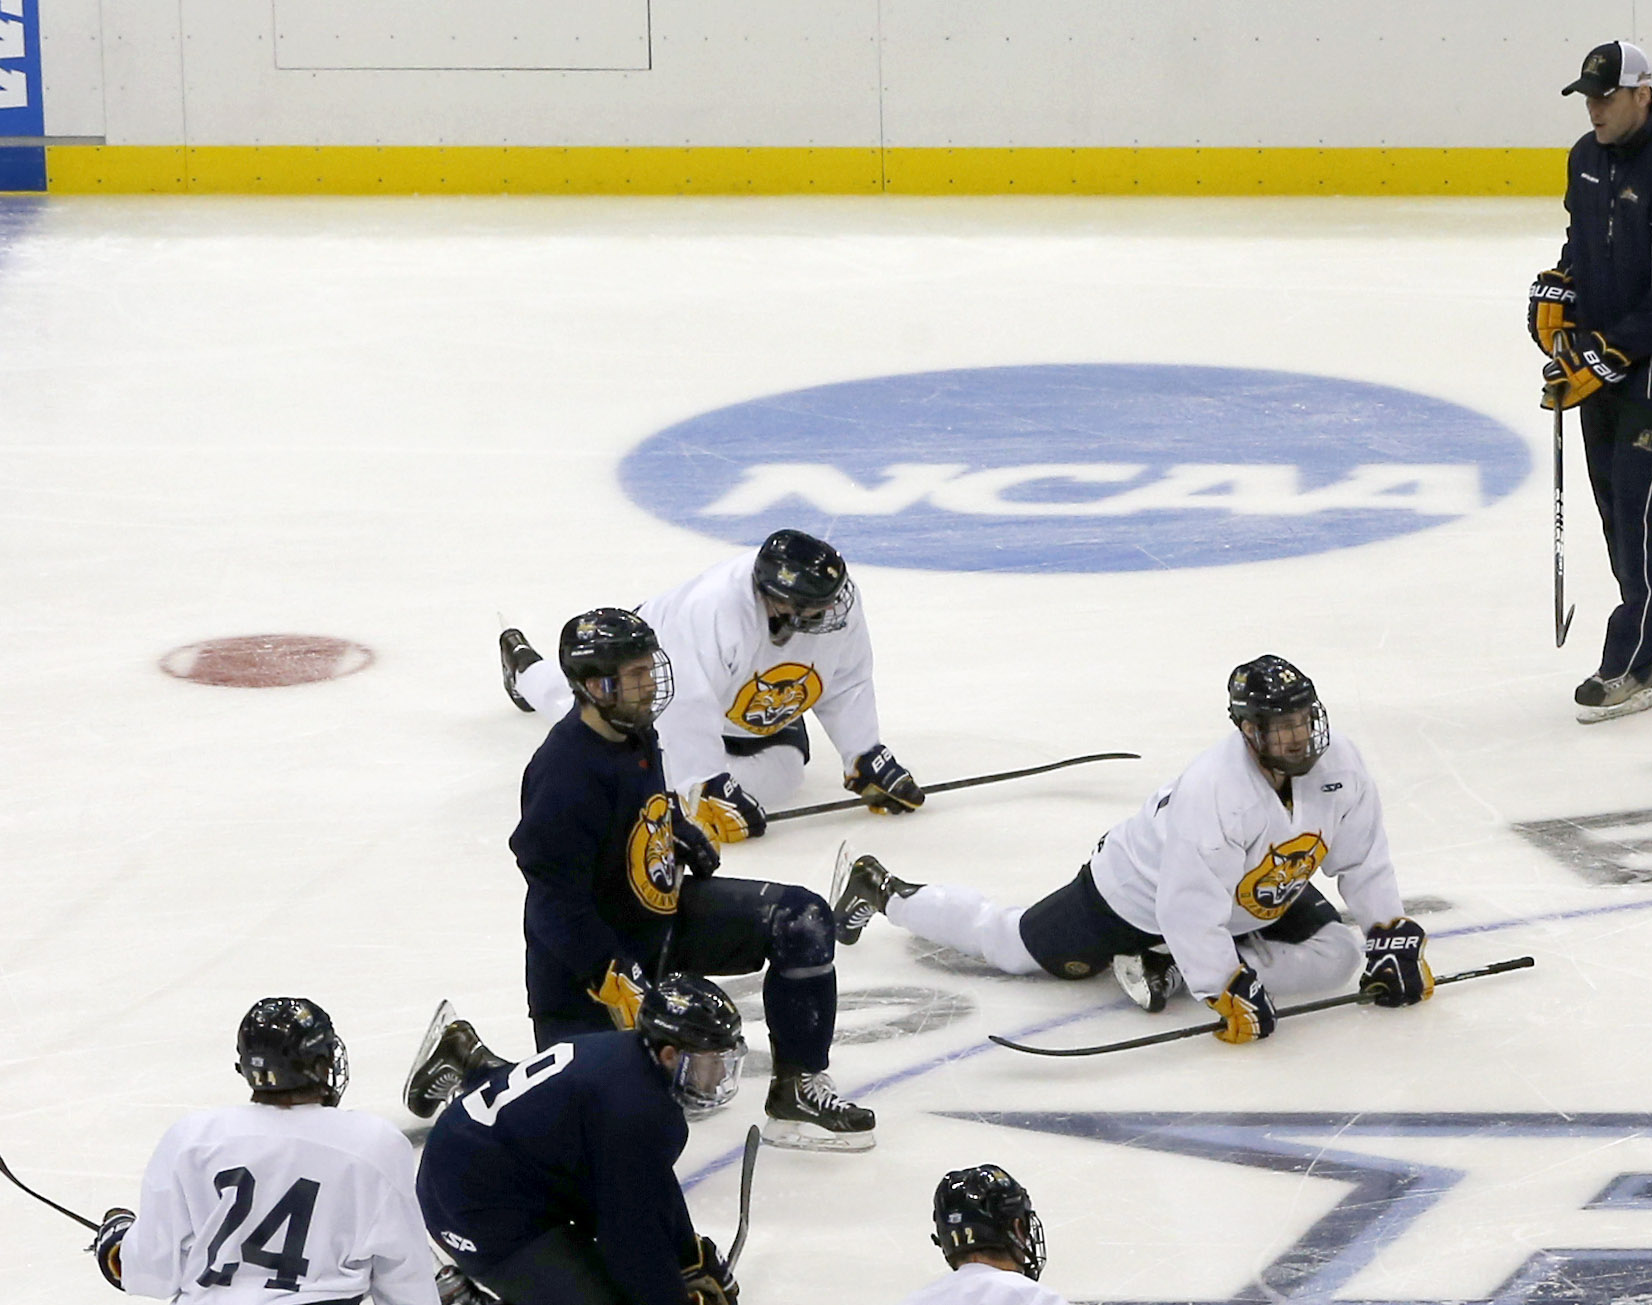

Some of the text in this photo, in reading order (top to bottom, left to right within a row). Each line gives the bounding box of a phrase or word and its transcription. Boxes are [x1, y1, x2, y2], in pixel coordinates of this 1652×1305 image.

[1528, 283, 1578, 303] AUER
[1584, 349, 1627, 383] BAU
[695, 463, 1485, 516] NCAA
[1364, 935, 1420, 951] AUER
[198, 1166, 321, 1293] 24
